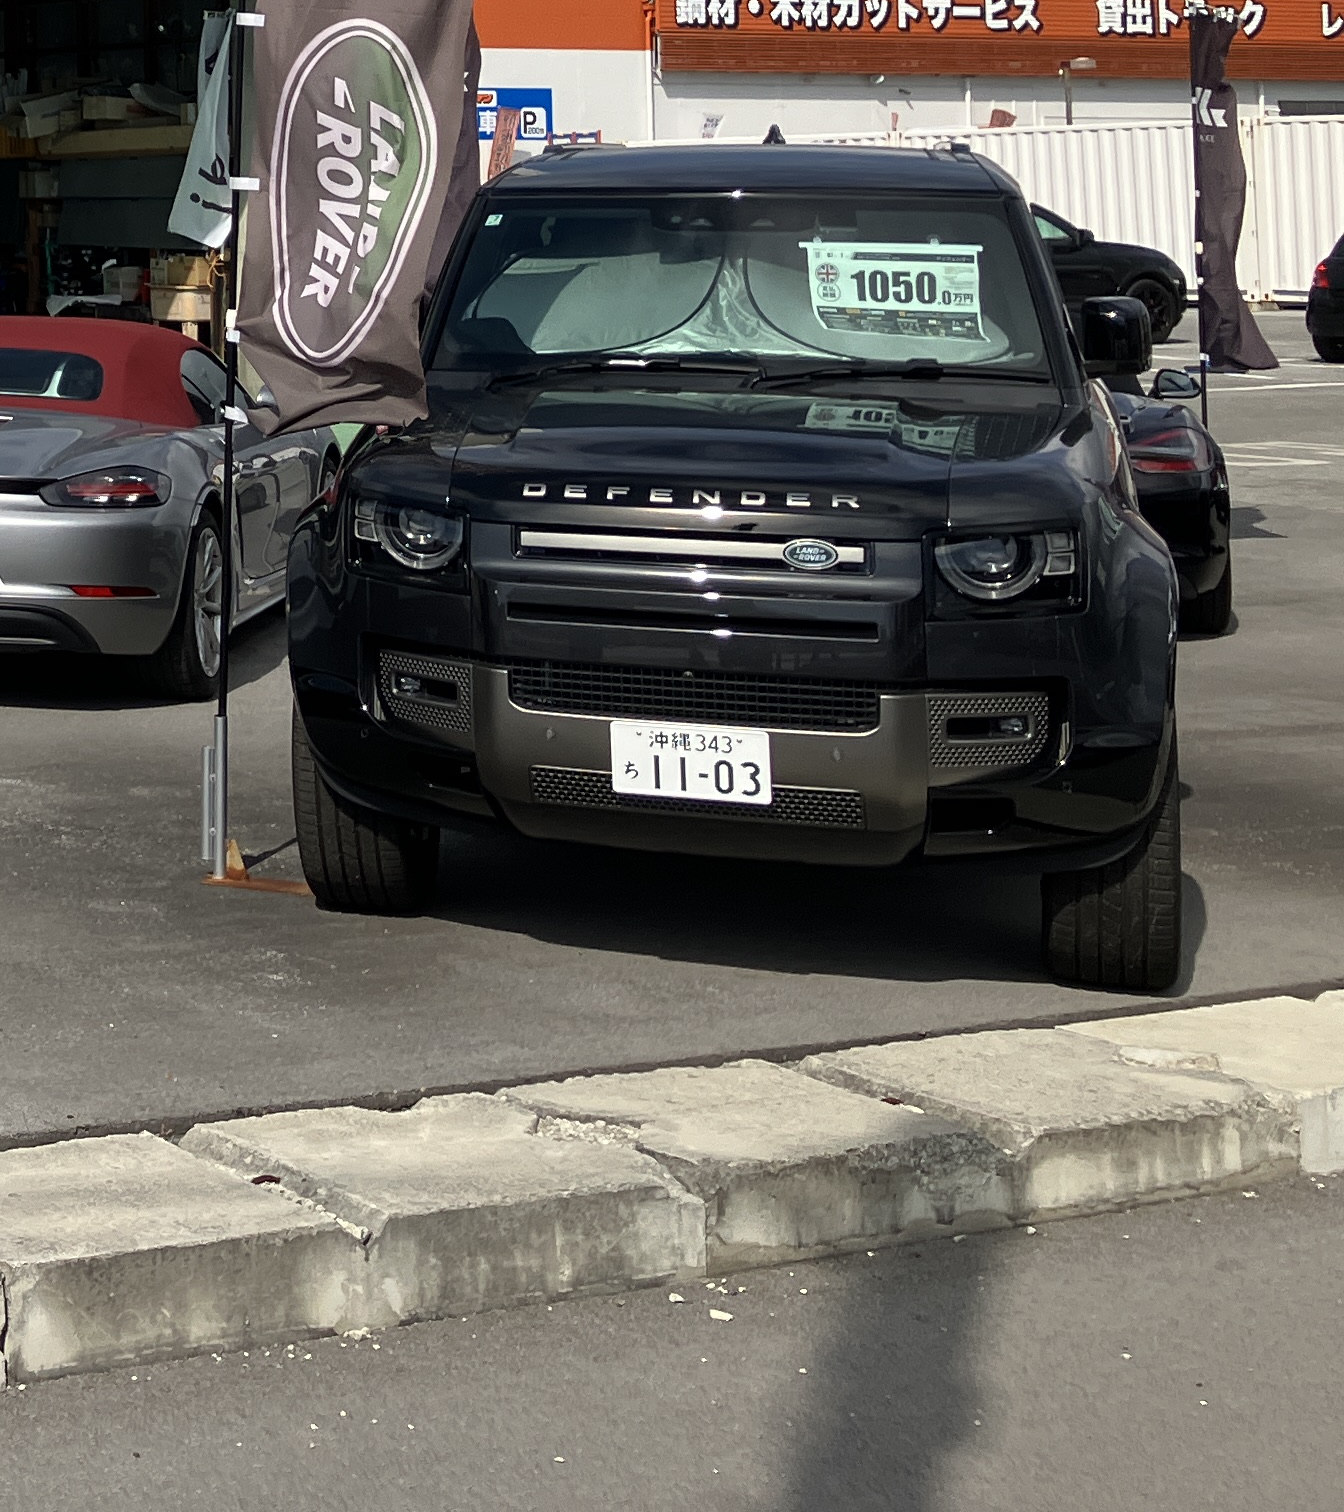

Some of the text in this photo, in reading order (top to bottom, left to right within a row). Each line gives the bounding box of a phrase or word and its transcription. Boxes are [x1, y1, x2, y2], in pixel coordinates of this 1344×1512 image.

[300, 109, 363, 308] ROVER
[522, 483, 860, 508] DEFENDER
[624, 754, 761, 796] ち 11-03
